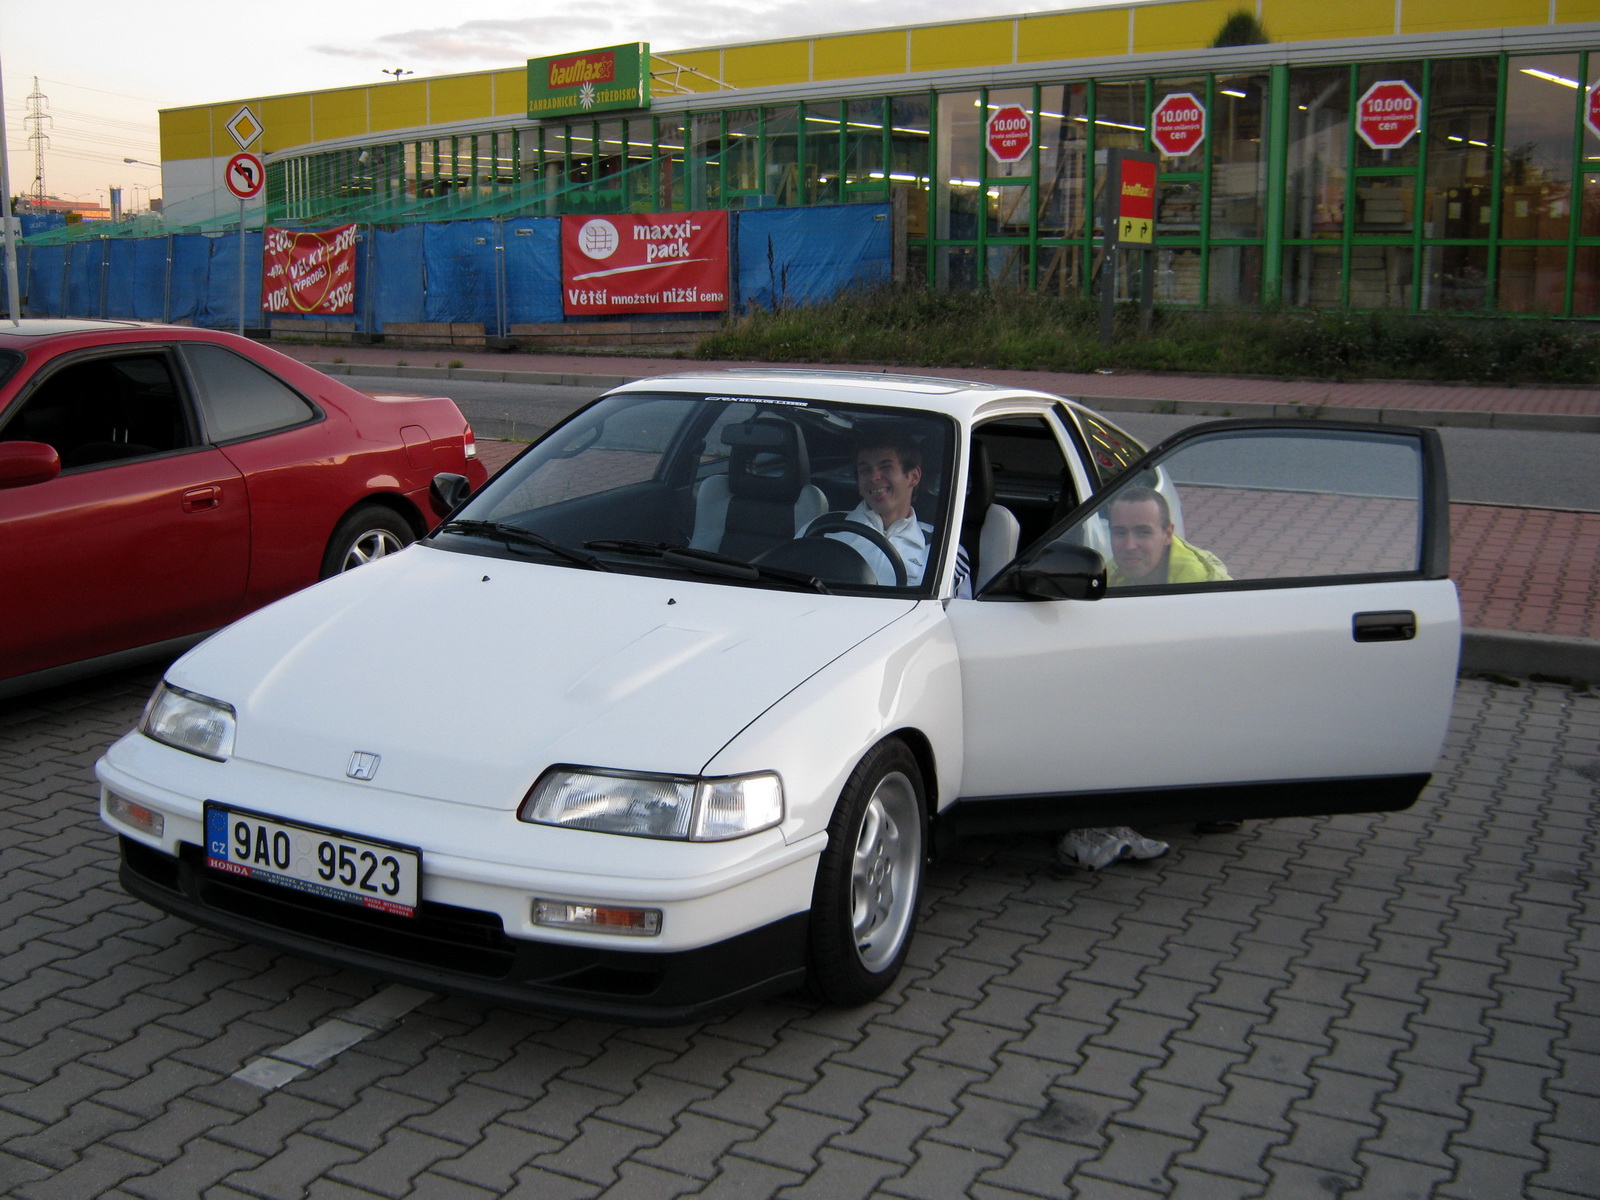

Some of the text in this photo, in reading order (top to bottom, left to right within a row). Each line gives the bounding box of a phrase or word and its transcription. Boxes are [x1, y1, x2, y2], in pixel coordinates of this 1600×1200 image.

[529, 88, 637, 112] ZAHRADNICKÉ STŘEDISKO
[1367, 97, 1413, 113] 10.000
[993, 118, 1027, 131] 10.000
[1160, 108, 1199, 123] 10.000
[1170, 131, 1187, 139] cen
[1378, 122, 1398, 131] cen
[1002, 139, 1016, 147] cen
[633, 220, 701, 240] maxxi-
[646, 238, 690, 263] pack
[290, 243, 324, 280] VELKÝ
[263, 286, 289, 312] -10%
[323, 282, 353, 312] -30%
[568, 286, 724, 305] Větší množství nižší cena
[211, 840, 226, 855] CZ
[210, 859, 249, 876] HONDA
[317, 841, 400, 896] 9523
